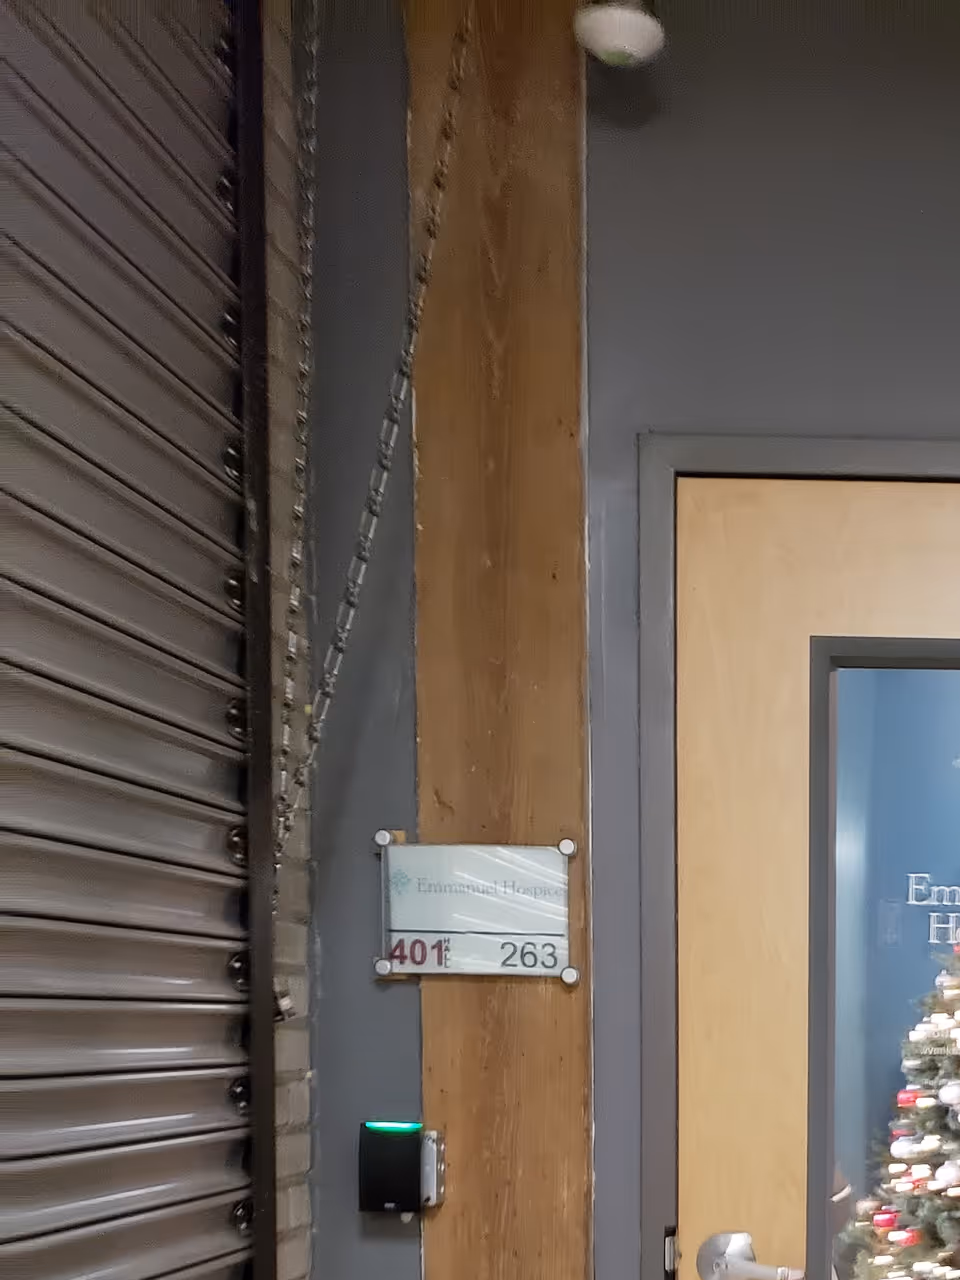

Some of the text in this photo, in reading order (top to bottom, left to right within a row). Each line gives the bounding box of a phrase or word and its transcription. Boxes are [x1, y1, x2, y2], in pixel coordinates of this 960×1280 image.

[416, 877, 497, 897] Emmanuel
[390, 938, 443, 967] 401
[500, 941, 558, 969] 263
